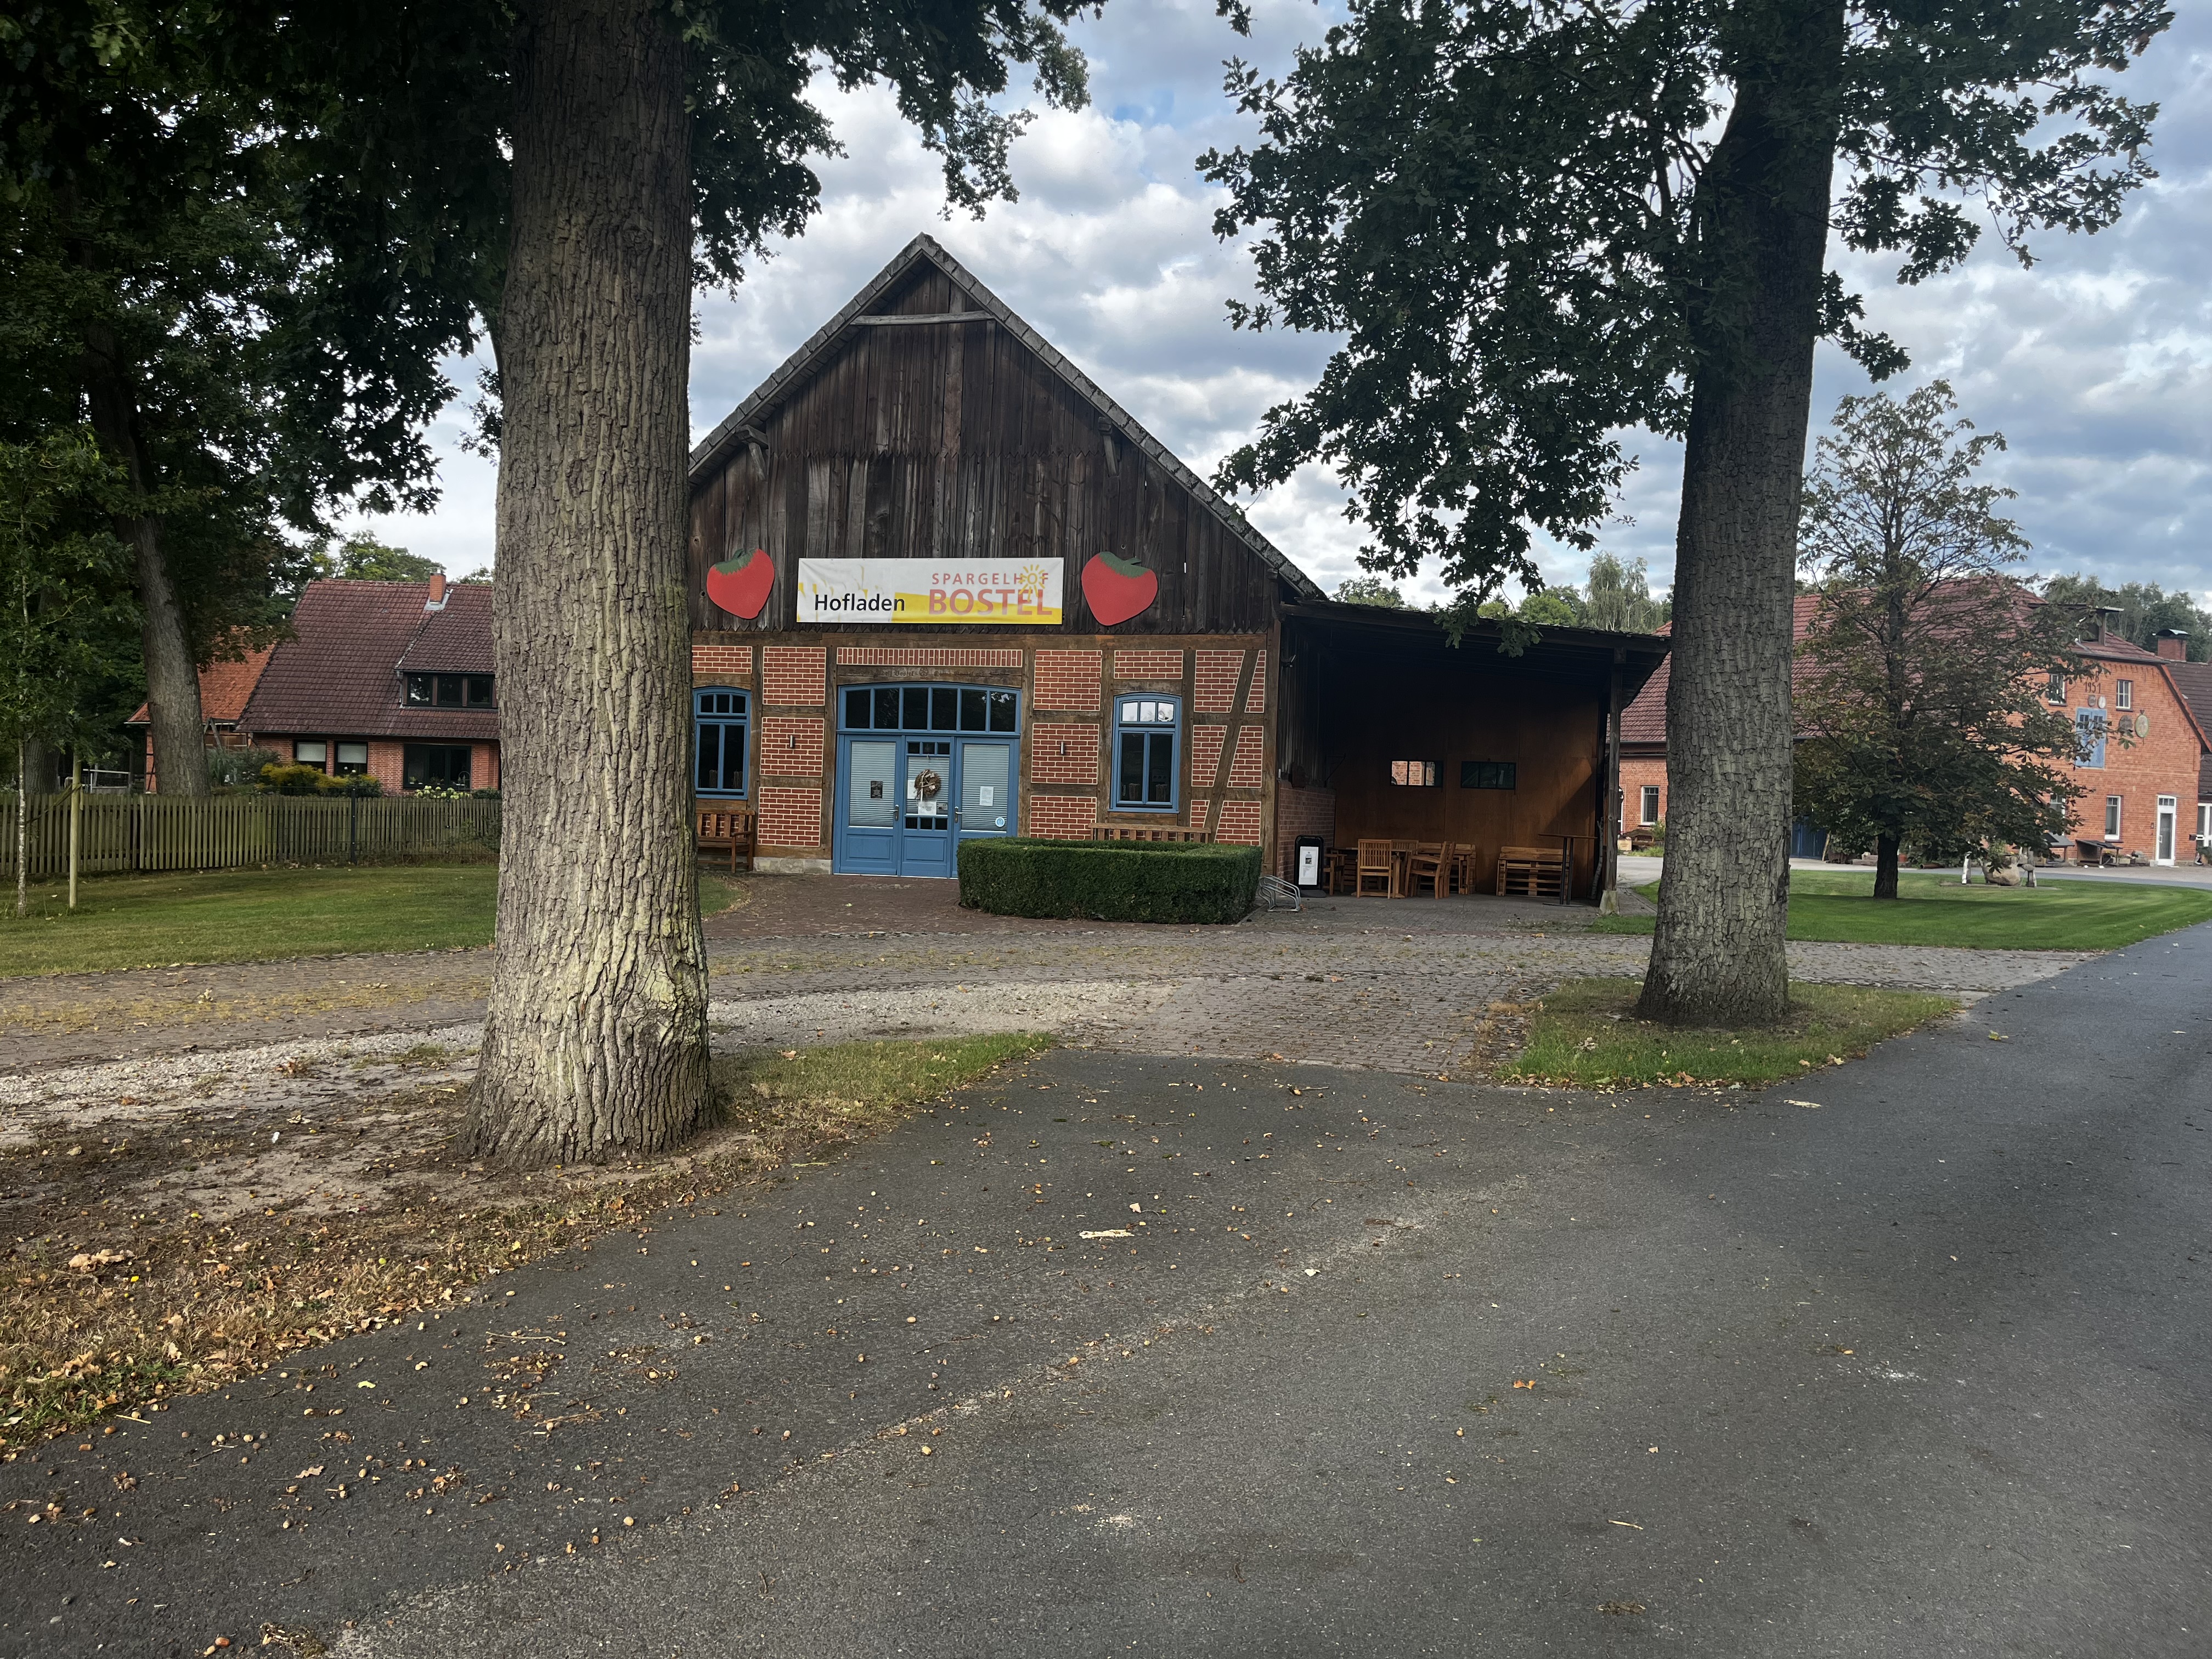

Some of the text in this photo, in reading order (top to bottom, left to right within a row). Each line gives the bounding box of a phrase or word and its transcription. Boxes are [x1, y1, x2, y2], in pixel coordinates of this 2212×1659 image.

[932, 572, 1049, 585] SPARGELHOF
[815, 593, 905, 611] Hofladen
[929, 589, 1053, 616] BOSTEL
[2083, 681, 2101, 694] 1951
